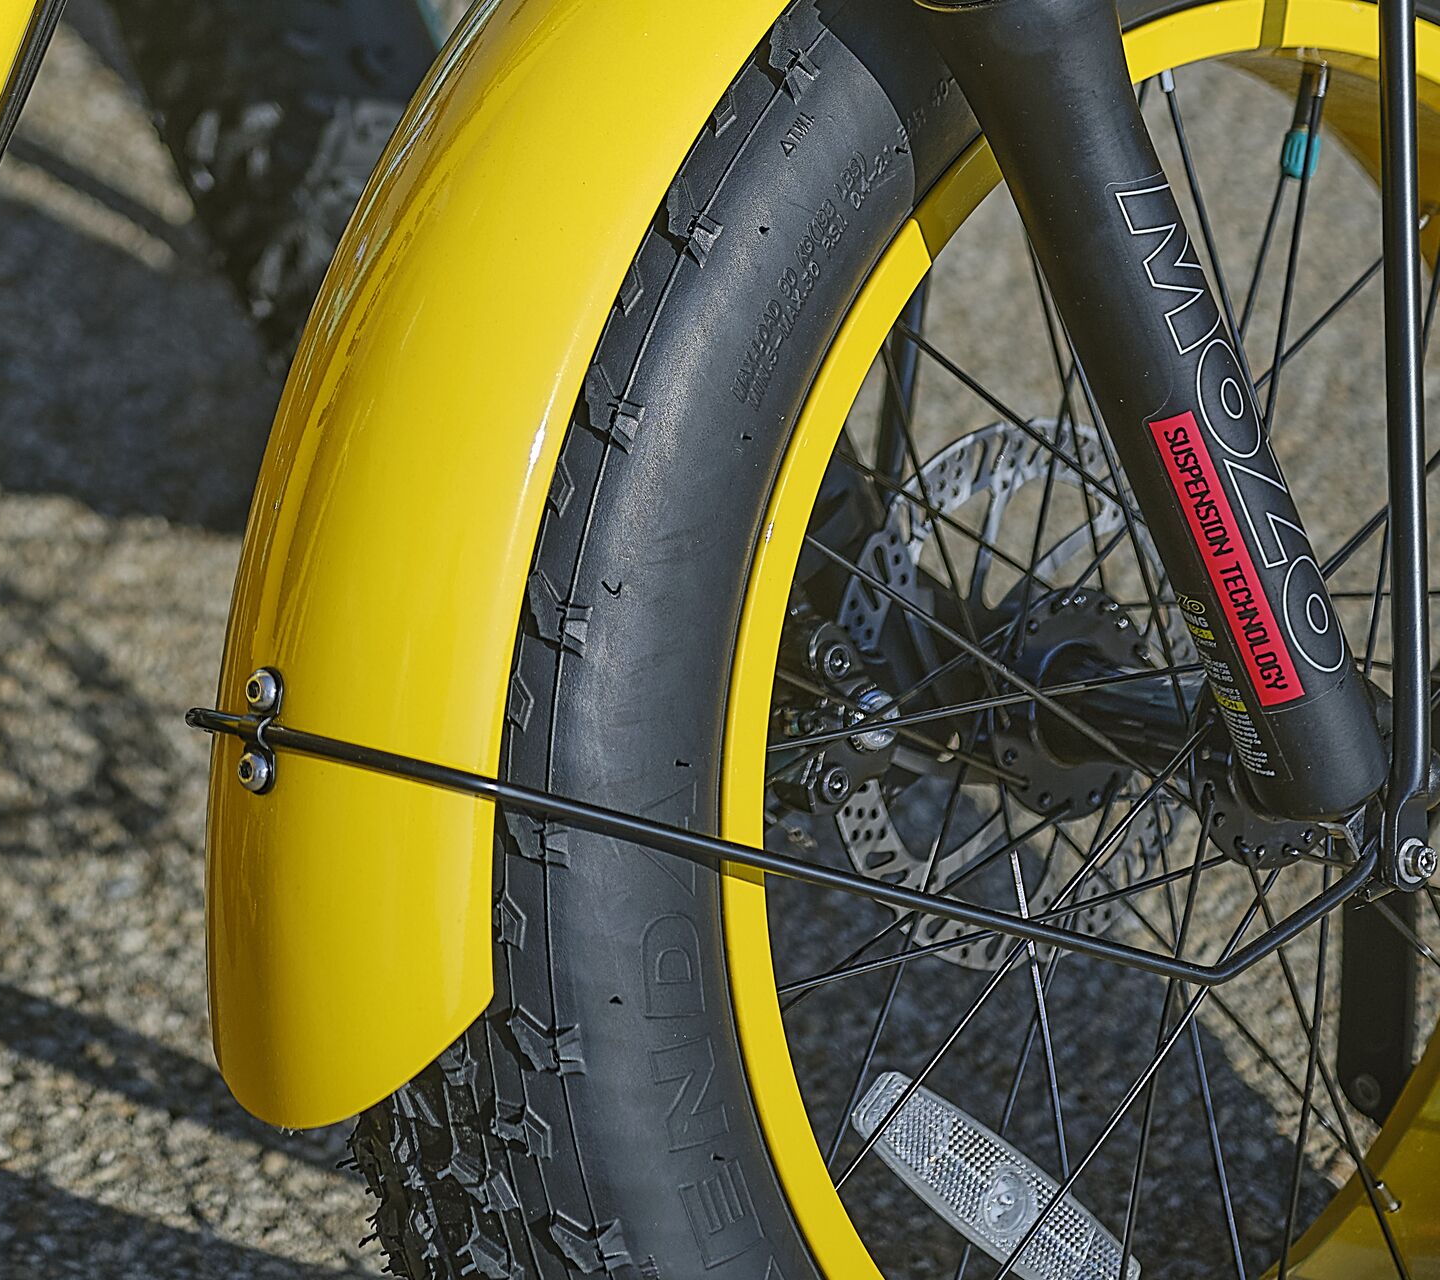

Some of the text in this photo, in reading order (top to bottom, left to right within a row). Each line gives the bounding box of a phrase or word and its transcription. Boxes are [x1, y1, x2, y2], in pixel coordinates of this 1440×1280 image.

[777, 266, 798, 298] 90
[1115, 183, 1346, 674] MOZO
[1162, 428, 1232, 558] SUSPENSION
[1218, 560, 1289, 691] TECHNOLOGY
[636, 781, 785, 1280] ENDA
